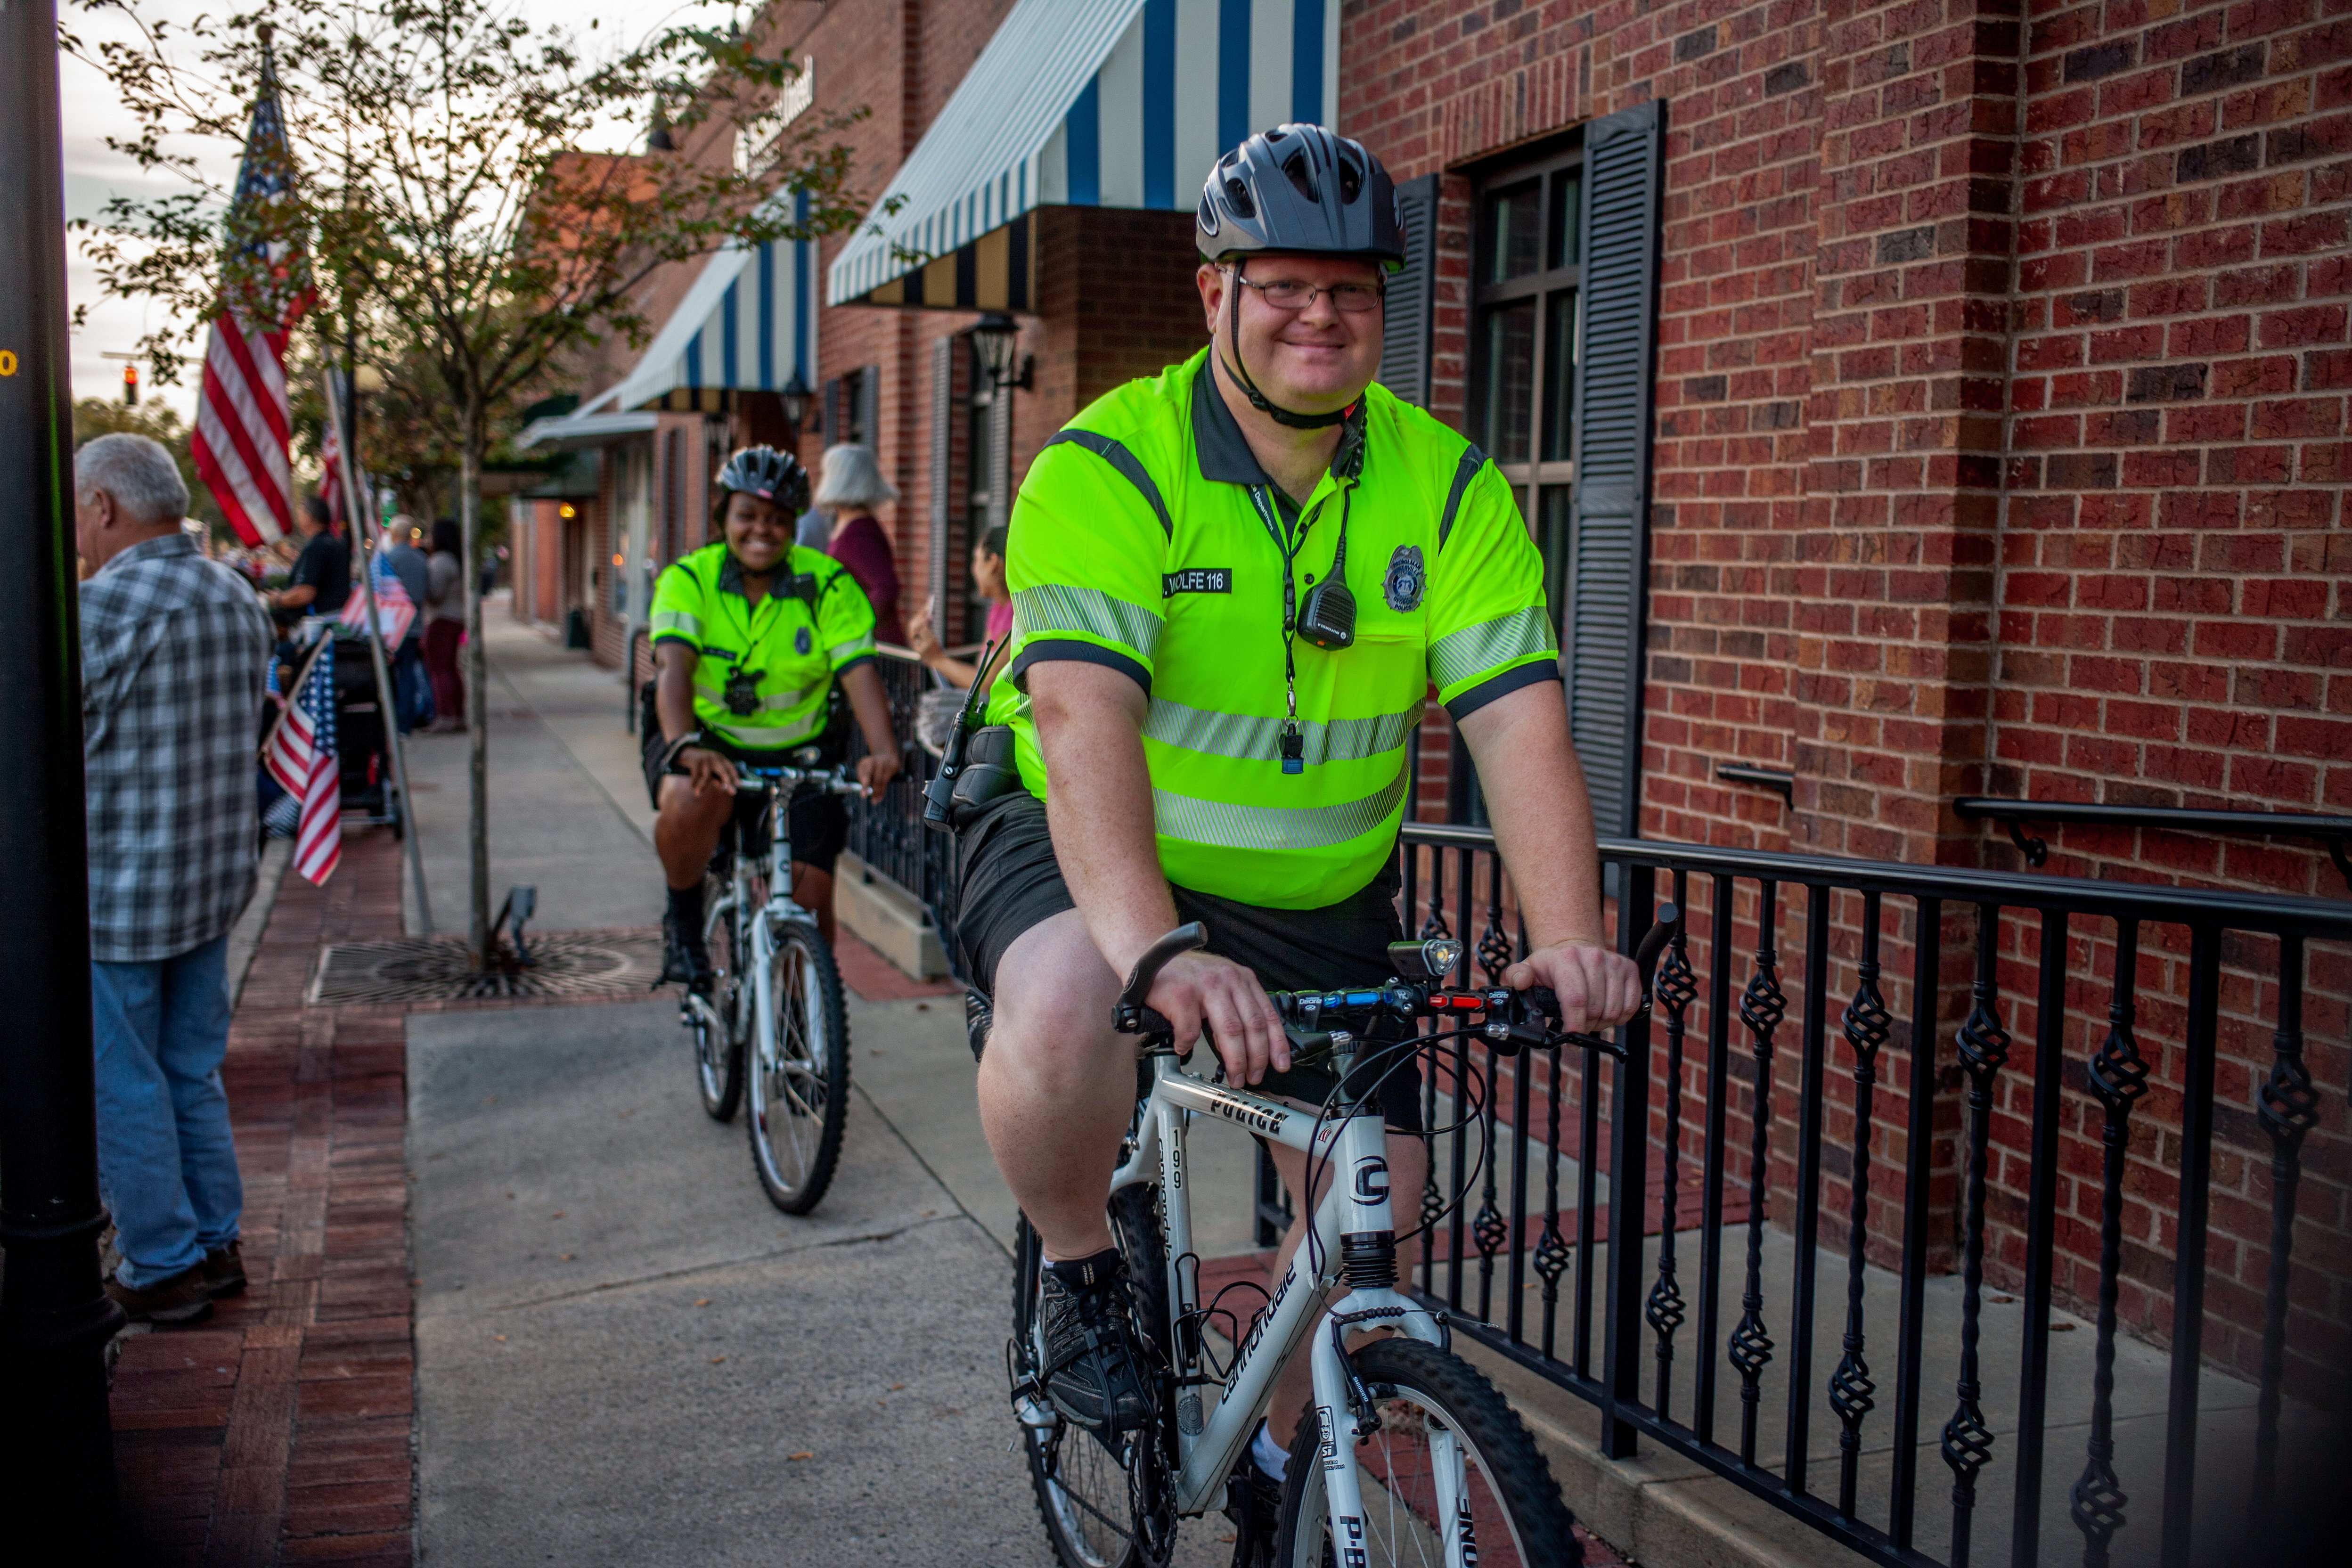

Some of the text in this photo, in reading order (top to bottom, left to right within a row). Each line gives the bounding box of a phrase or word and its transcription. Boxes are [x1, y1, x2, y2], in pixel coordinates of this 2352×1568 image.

[1255, 491, 1273, 532] Department
[1169, 572, 1204, 594] WOLFE
[1207, 572, 1223, 590] 116
[1317, 622, 1340, 635] MOTOROLA
[1210, 1093, 1290, 1135] POLICE
[1353, 1376, 1369, 1402] SHIMANO
